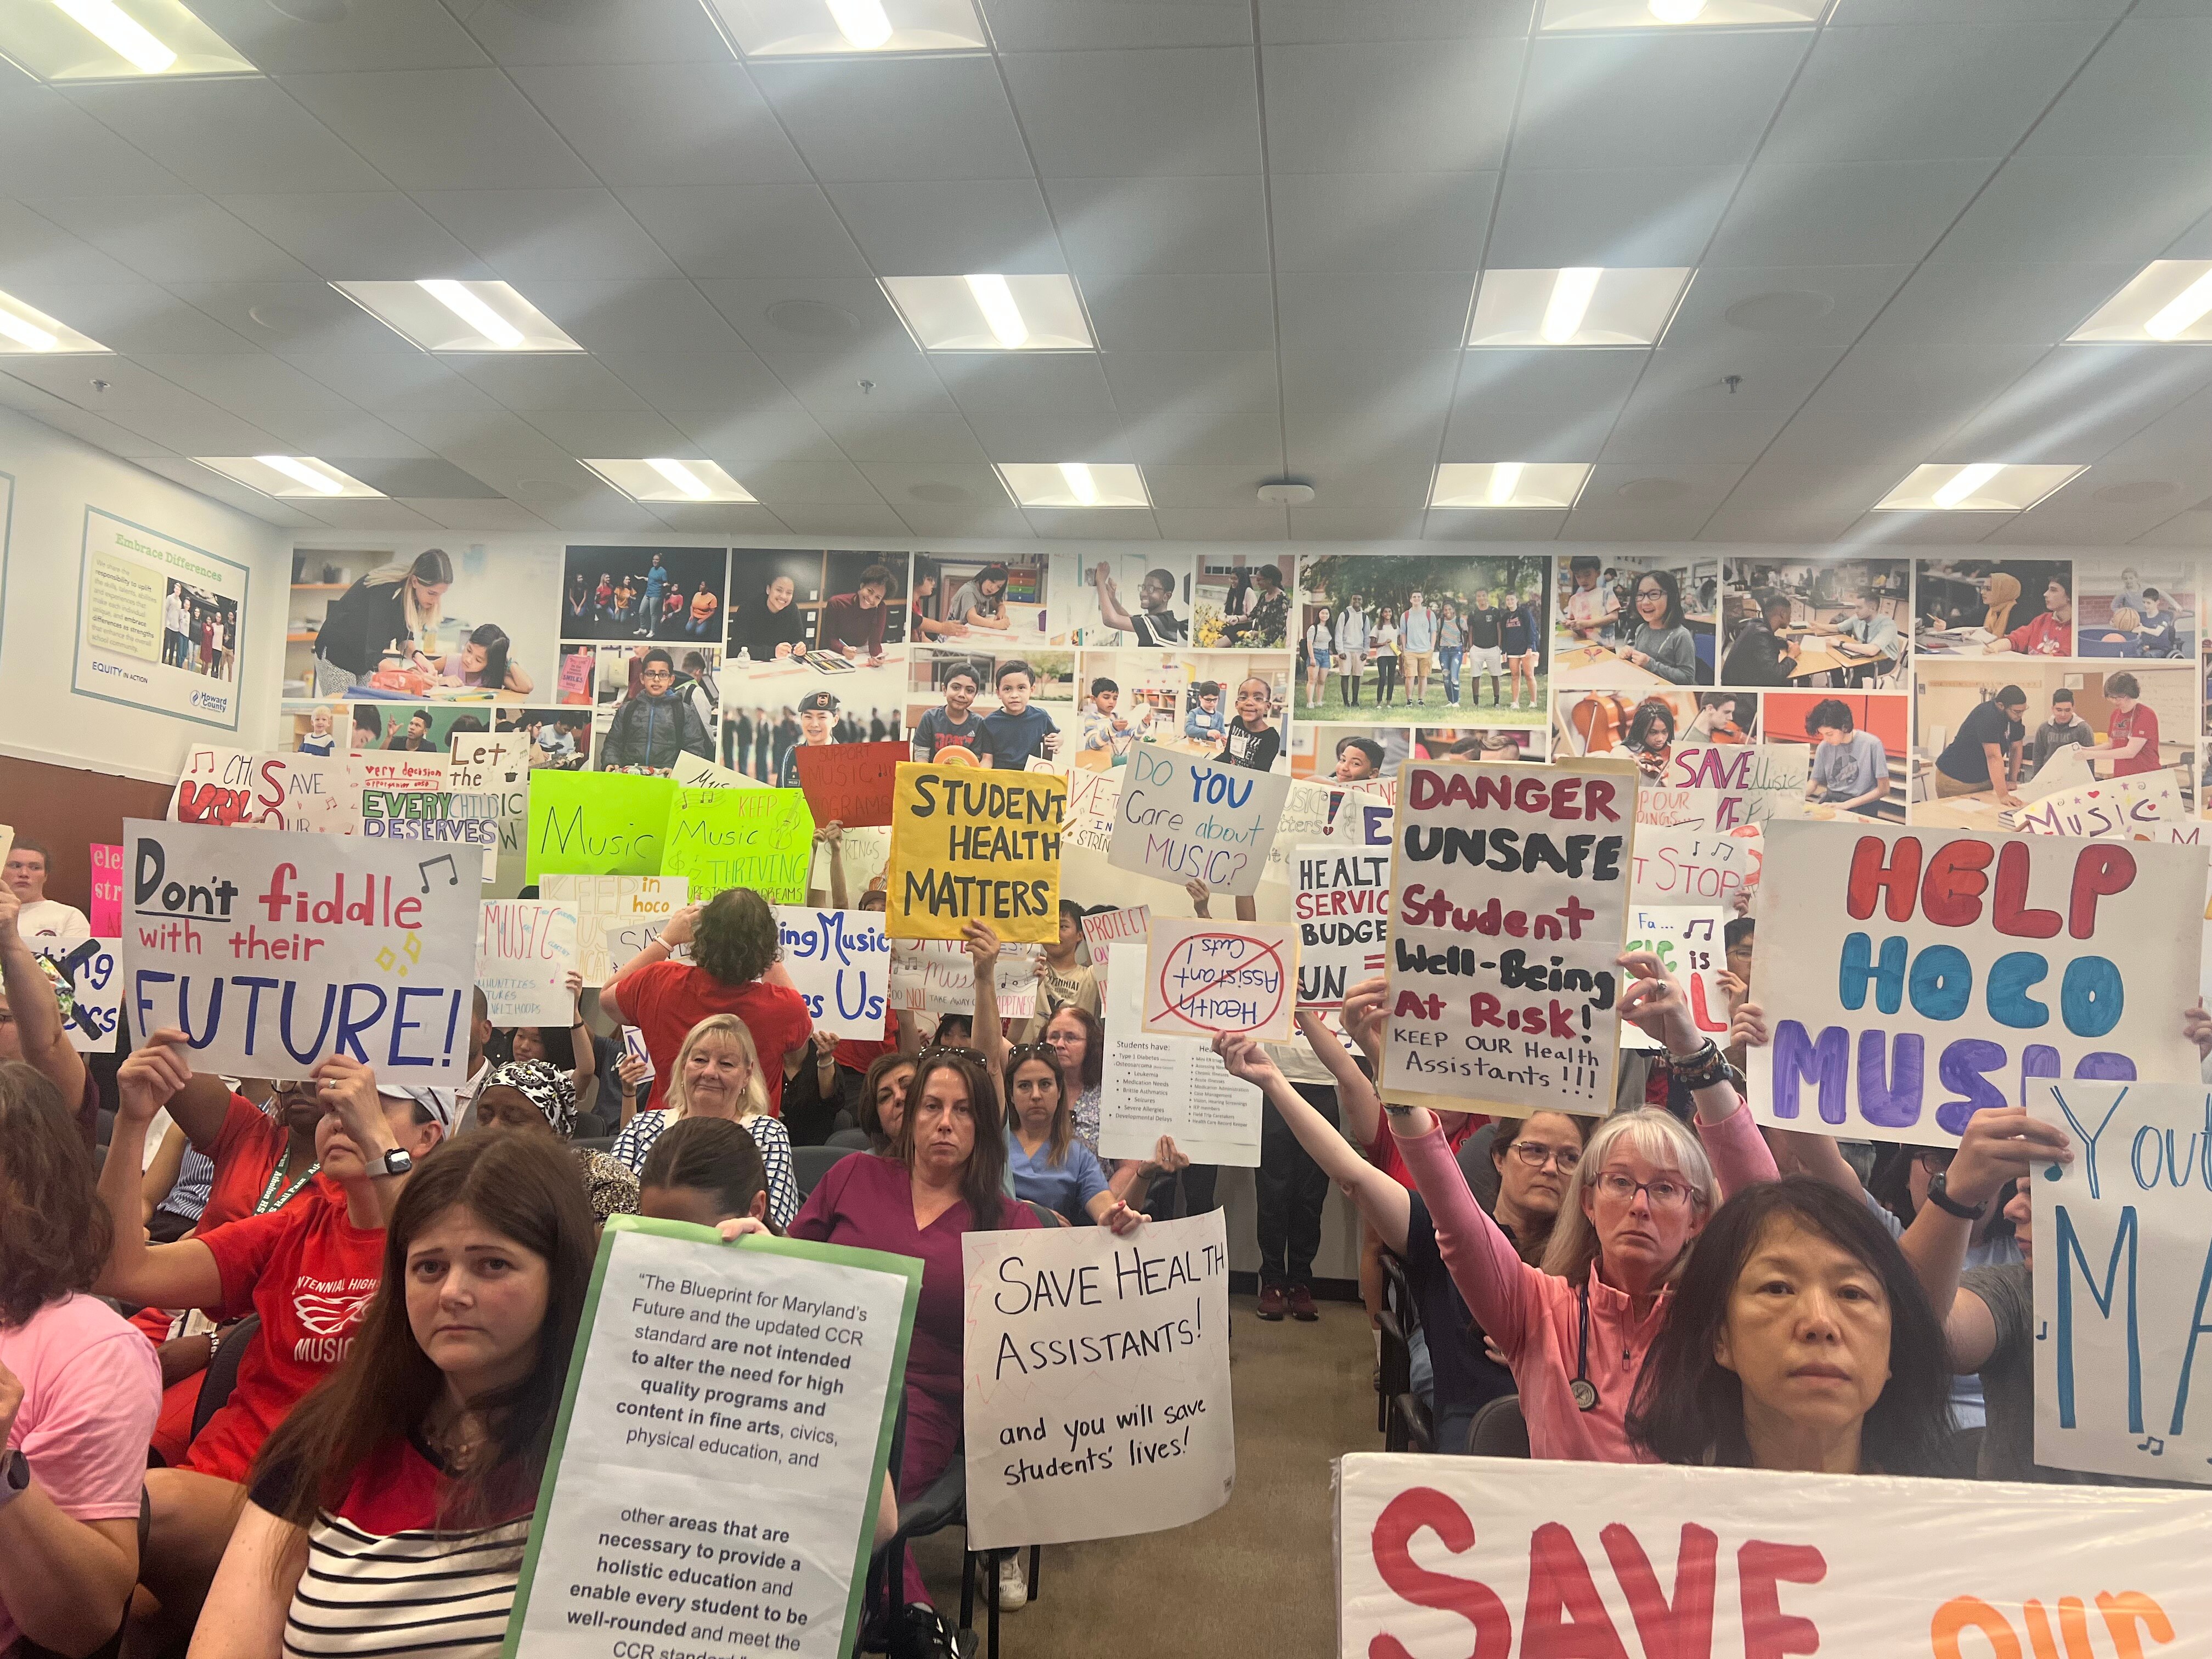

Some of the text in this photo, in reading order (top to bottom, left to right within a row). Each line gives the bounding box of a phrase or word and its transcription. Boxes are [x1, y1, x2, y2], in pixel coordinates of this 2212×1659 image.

[115, 533, 222, 582] Embrace Differences
[95, 570, 130, 586] responsibility
[138, 583, 152, 592] uplift
[92, 615, 154, 638] differences strengths
[125, 617, 146, 627] embrace
[92, 662, 123, 676] EQUITY
[129, 674, 148, 683] ACTION
[201, 692, 227, 705] Howard
[202, 699, 226, 712] County
[403, 762, 441, 777] decision
[451, 736, 506, 765] Let
[819, 744, 872, 761] SUPPORT
[1675, 748, 1754, 789] SAVE
[258, 760, 326, 807] SAVE
[449, 771, 481, 787] the
[809, 763, 873, 786] MUSIC
[1135, 751, 1254, 809] DO YOU
[363, 790, 499, 820] EVERY CHILD
[738, 795, 777, 817] KEEP
[911, 775, 1067, 824] STUDENT
[1409, 769, 1621, 822] DANGER
[364, 819, 497, 844] DESERVES
[541, 805, 655, 859] Music
[672, 820, 758, 845] Music
[1125, 789, 1265, 847] Care about
[949, 825, 1060, 861] HEALTH
[1145, 833, 1248, 886] MUSIC?
[1404, 825, 1623, 881] UNSAFE
[135, 837, 422, 929] Don't fiddle
[642, 877, 660, 893] in
[707, 854, 808, 884] THRIVING
[1300, 856, 1389, 890] HEALT
[1656, 848, 1740, 898] STOP
[1847, 836, 2137, 939] HELP
[543, 876, 639, 915] KEEP
[633, 895, 669, 913] hoco
[904, 868, 1049, 919] MATTERS
[1296, 889, 1389, 919] SERVIC
[1401, 883, 1594, 941] Student
[139, 918, 202, 955] with
[228, 924, 325, 961] their
[484, 905, 561, 960] MUSIC
[780, 911, 889, 966] ing Music
[1084, 907, 1148, 943] PROTECT
[1302, 920, 1386, 946] BUDGE
[1173, 967, 1279, 993] Assistant
[1689, 951, 1710, 970] is
[836, 969, 884, 1020] Us
[891, 988, 969, 1008] DO NOT TAKE AWAY
[1838, 932, 2124, 1037] HOCO
[137, 969, 461, 1068] FUTURE!
[1179, 994, 1257, 1024] Health
[1394, 990, 1447, 1020] At
[1117, 1041, 1149, 1049] Students
[1394, 1028, 1599, 1066] KEEP OUR Health
[1406, 1051, 1550, 1087] Assistants
[256, 1171, 282, 1213] Atholton HS
[274, 1178, 307, 1207] Hall Pass
[348, 1278, 377, 1290] HIGH
[994, 1242, 1224, 1314] SAVE HEALTH
[680, 1280, 752, 1305] Blueprint
[757, 1291, 778, 1308] for
[782, 1295, 867, 1322] Maryland's
[633, 1298, 863, 1346] Future and the updated CCR
[996, 1297, 1202, 1380] ASSISTANTS!
[635, 1325, 851, 1369] standard are not intended
[632, 1349, 844, 1395] to alter the need for high
[641, 1378, 826, 1417] quality programs and
[616, 1401, 838, 1447] content in fine arts, civics,
[1000, 1399, 1206, 1452] and you will save
[626, 1427, 819, 1468] physical education, and
[1003, 1426, 1189, 1486] students' lives!
[621, 1507, 789, 1543] other areas that are
[598, 1533, 800, 1572] necessary to provide a
[596, 1556, 793, 1597] holistic education and
[1368, 1486, 1829, 1659] SAVE
[570, 1583, 808, 1625] enable every student to be
[567, 1610, 800, 1651] well-rounded and meet the
[613, 1640, 654, 1659] CCR
